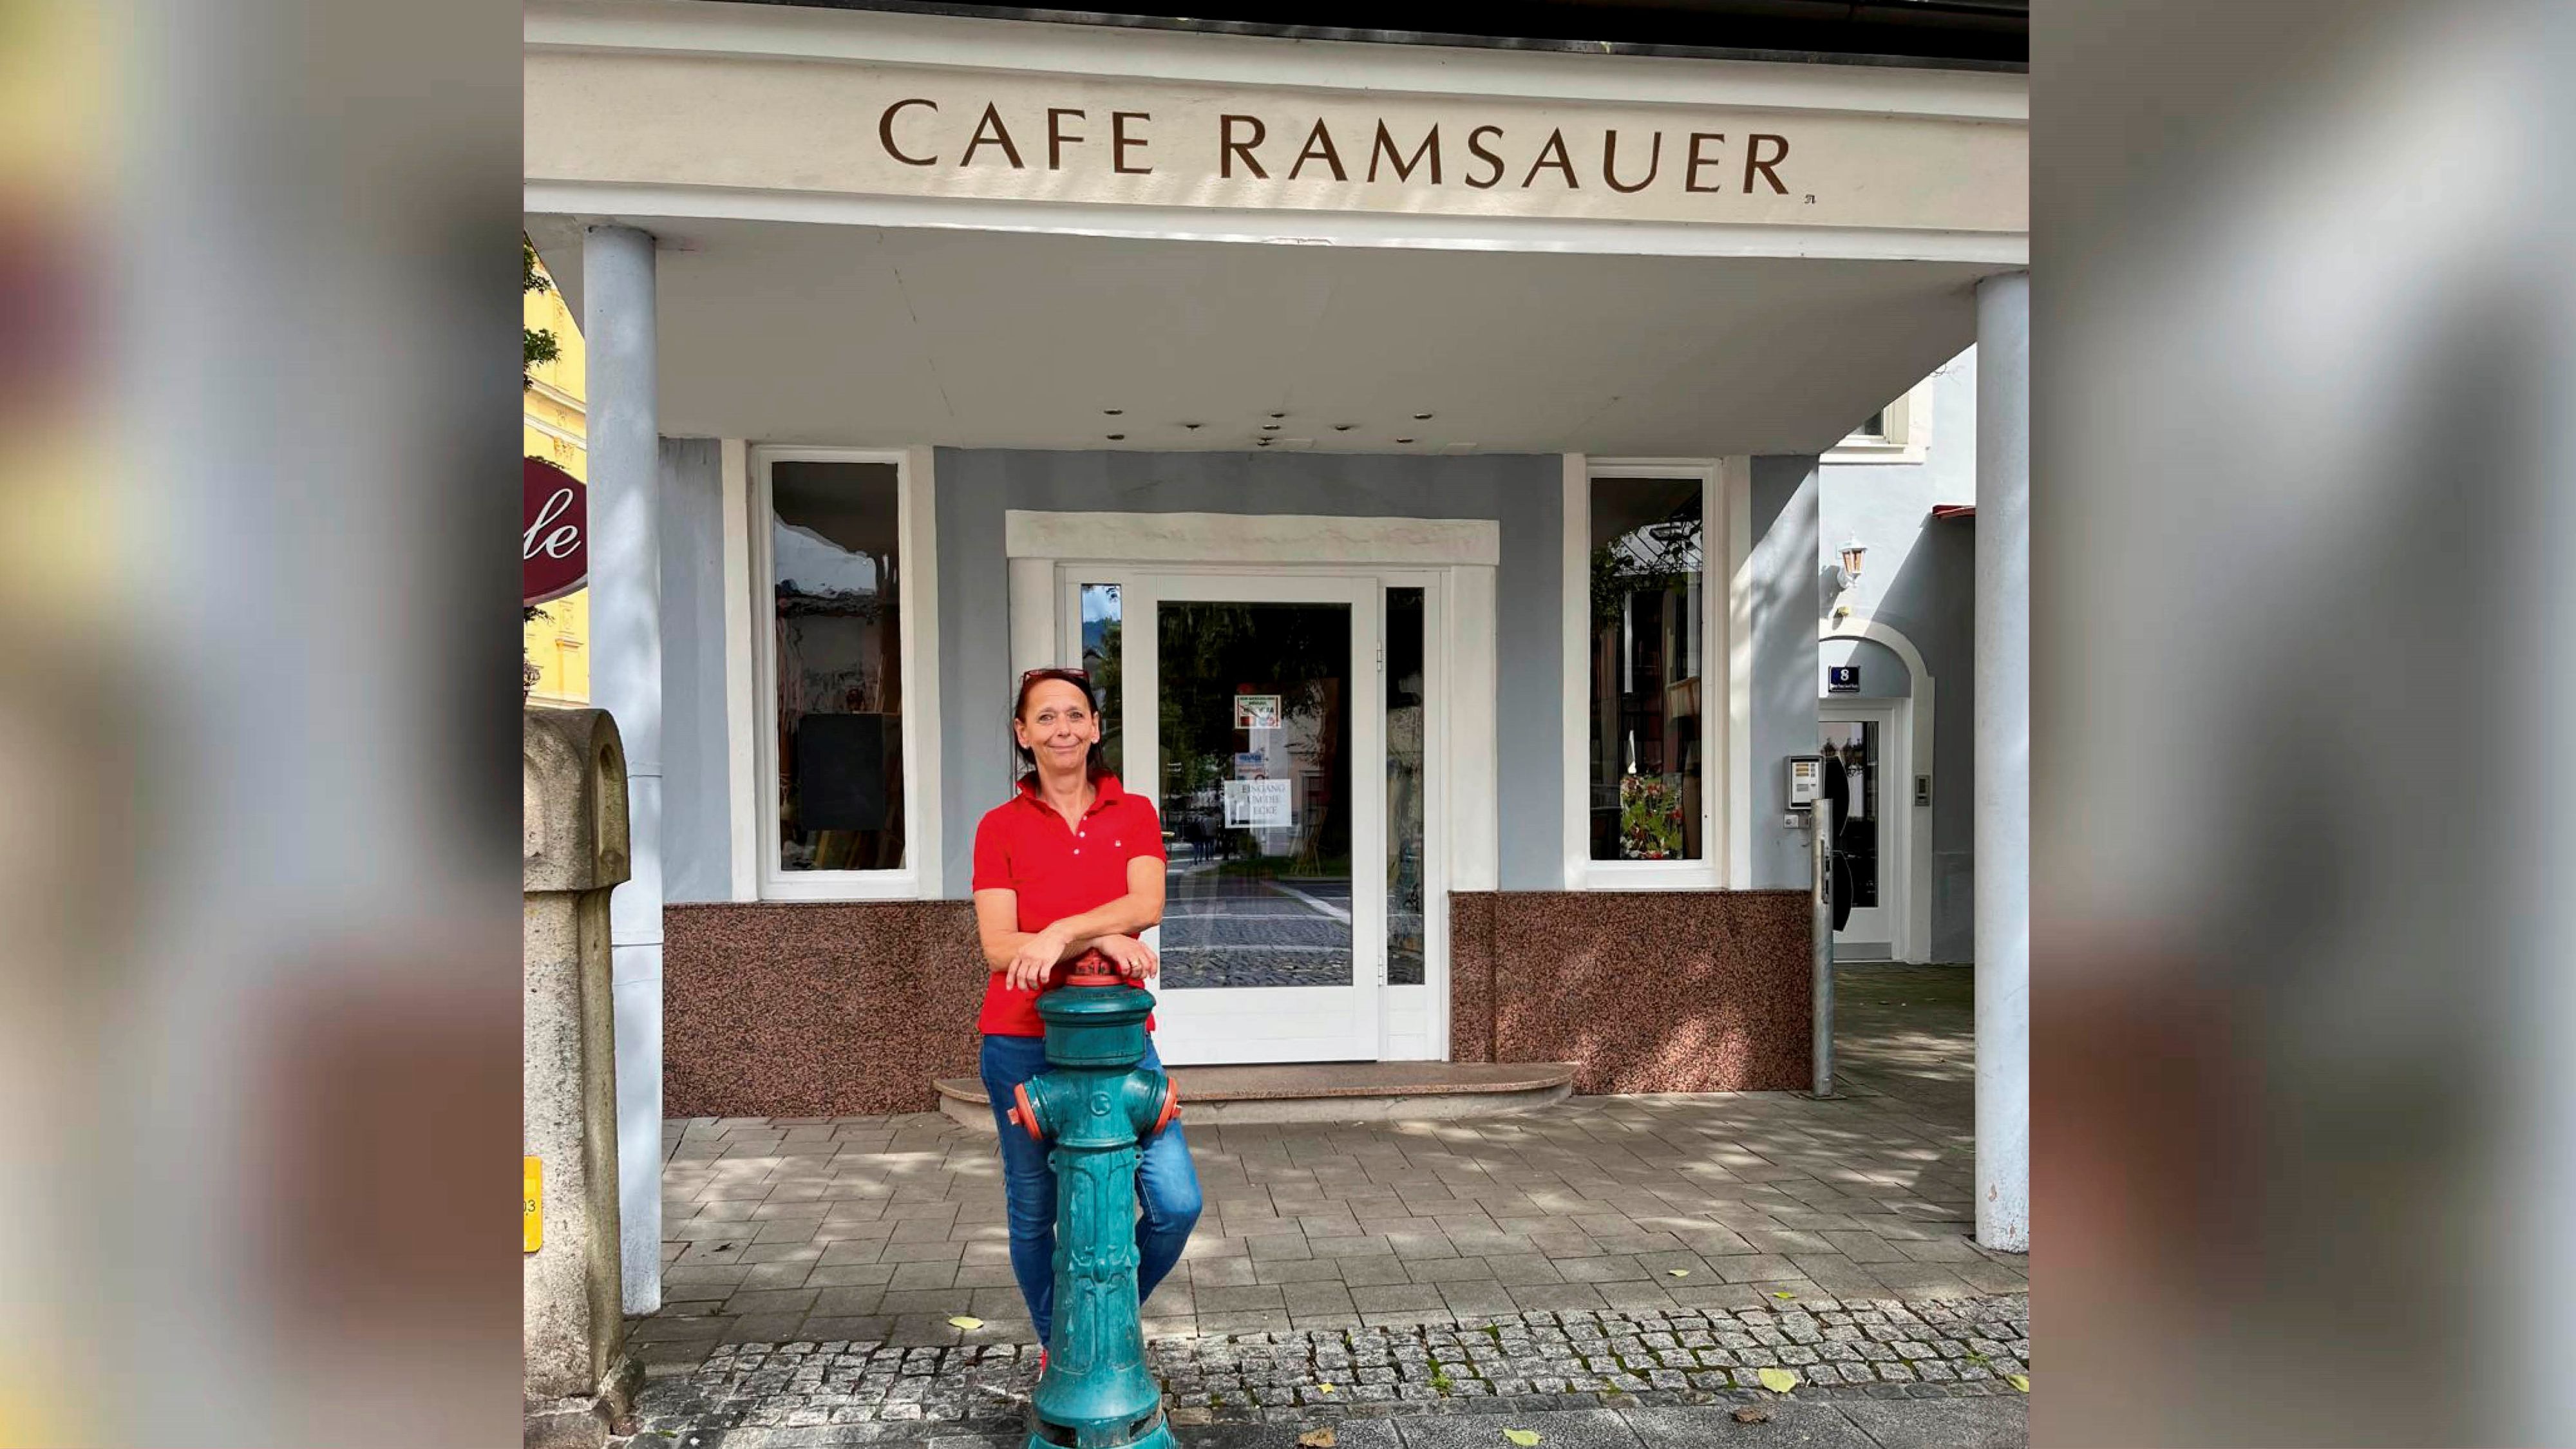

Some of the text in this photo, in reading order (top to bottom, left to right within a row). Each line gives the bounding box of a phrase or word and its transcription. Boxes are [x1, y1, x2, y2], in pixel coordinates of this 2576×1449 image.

[879, 99, 1790, 194] CAFE RAMSAUER
[1841, 669, 1849, 681] 8
